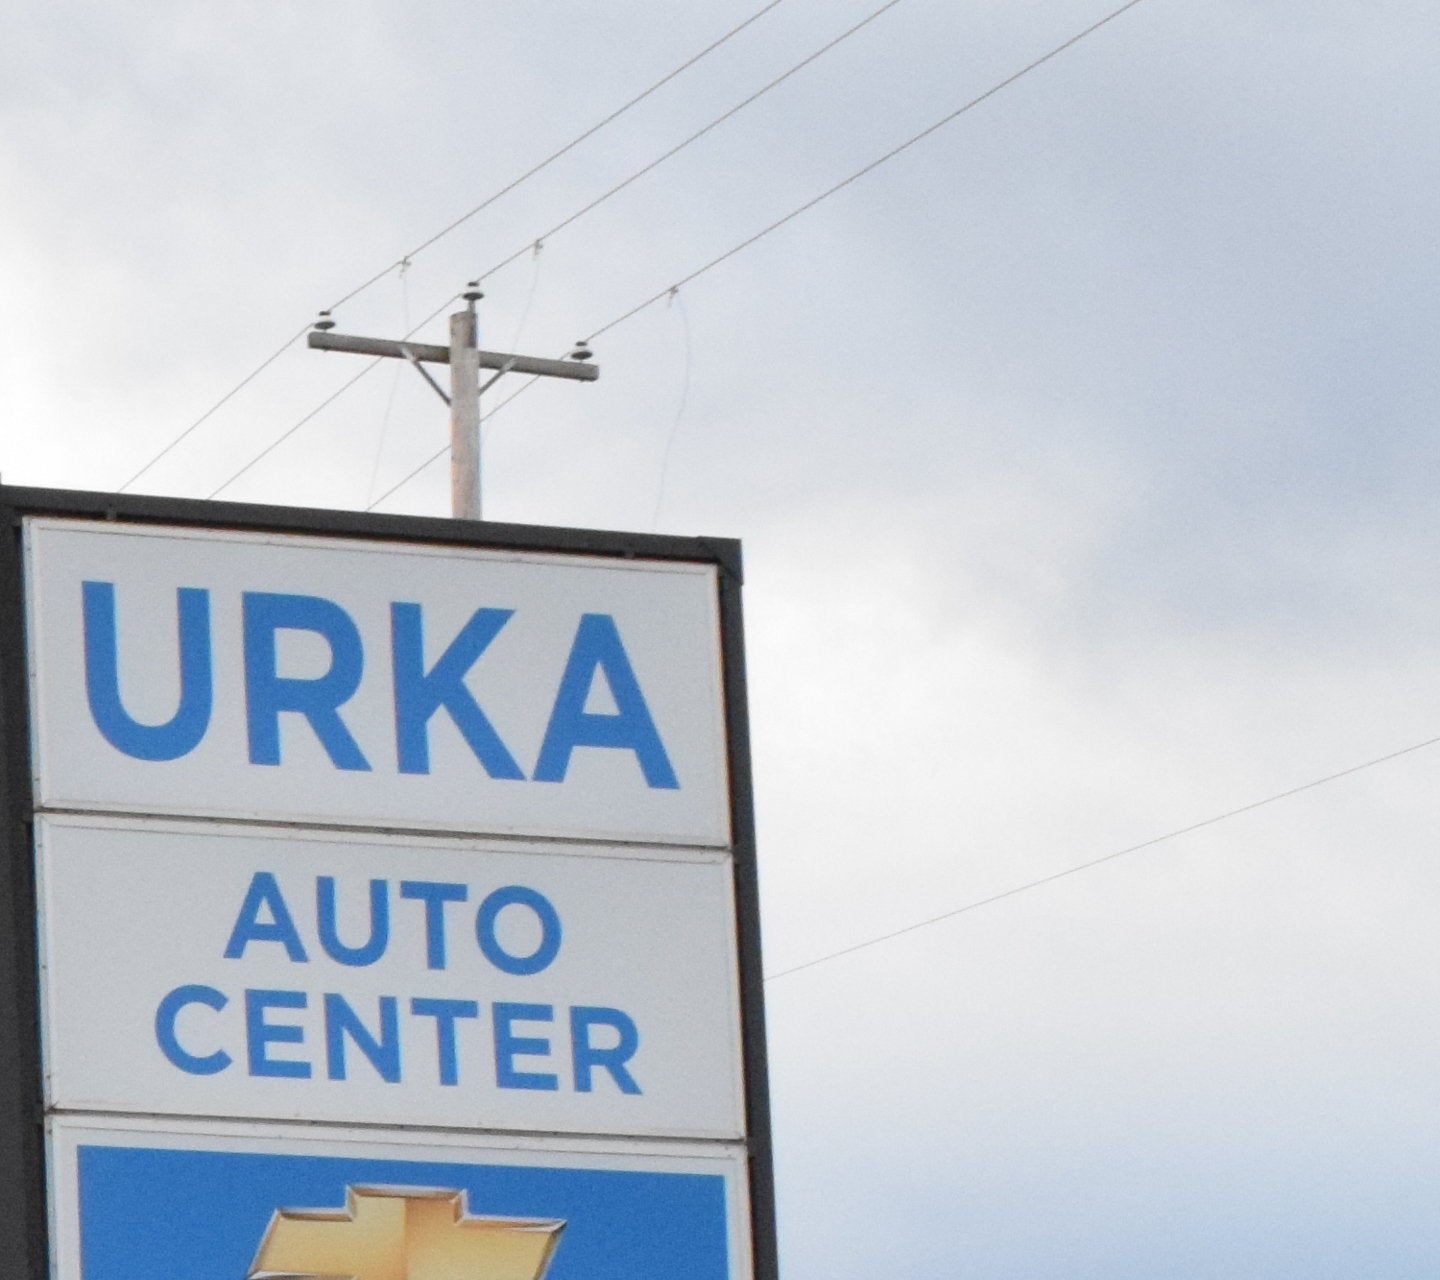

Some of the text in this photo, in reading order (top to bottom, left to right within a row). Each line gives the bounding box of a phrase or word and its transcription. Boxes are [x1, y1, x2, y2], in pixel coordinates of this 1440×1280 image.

[82, 580, 678, 789] URKA
[225, 872, 562, 976] AUTO
[155, 984, 642, 1095] CENTER
